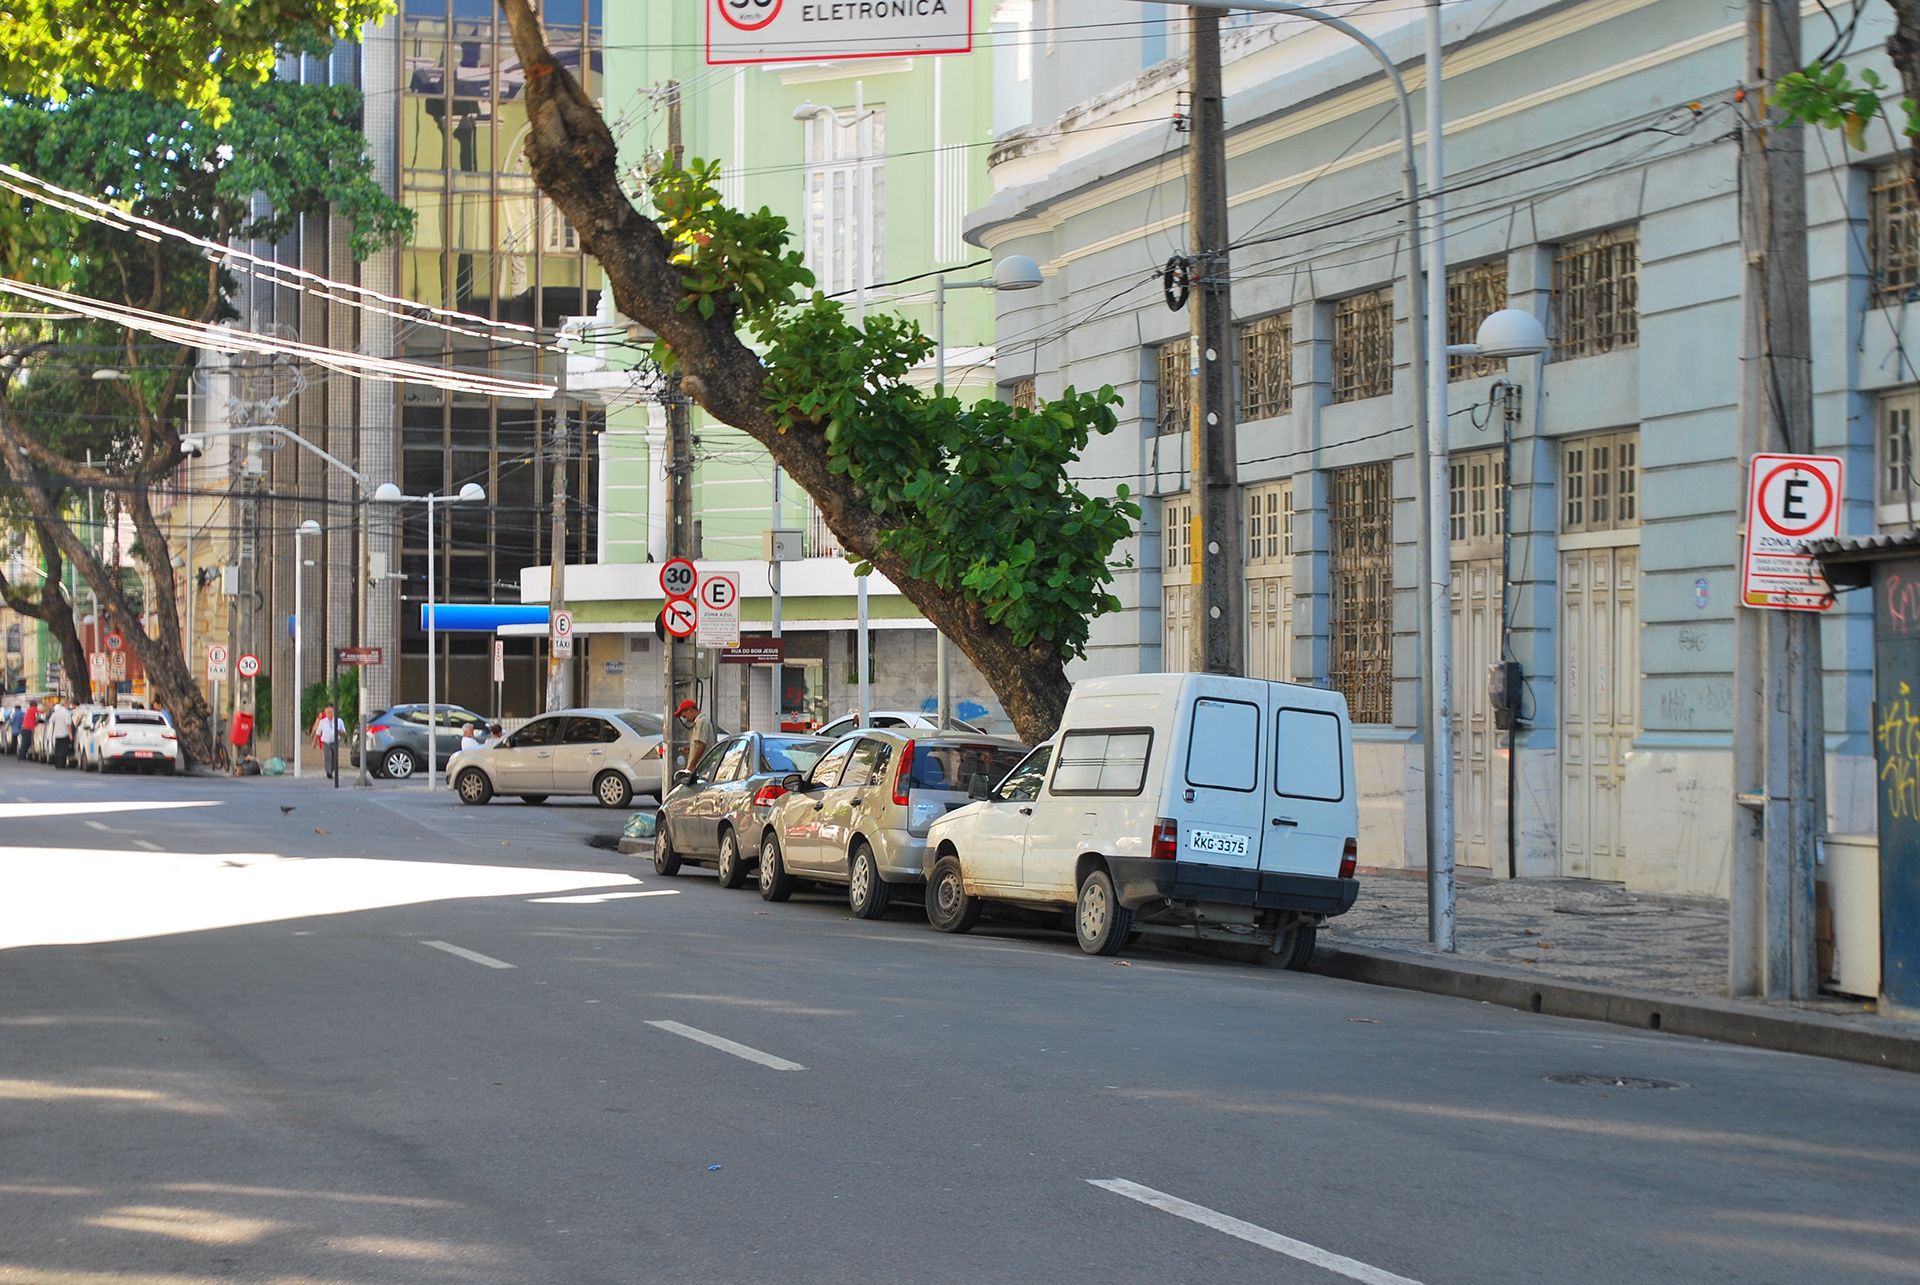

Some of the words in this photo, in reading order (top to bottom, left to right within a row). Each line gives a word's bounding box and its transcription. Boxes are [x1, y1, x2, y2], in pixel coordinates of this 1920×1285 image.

[1783, 480, 1809, 519] E
[1760, 537, 1791, 546] ZONA
[666, 567, 691, 584] 30
[712, 584, 725, 603] E
[560, 618, 566, 631] E
[241, 659, 256, 670] 30
